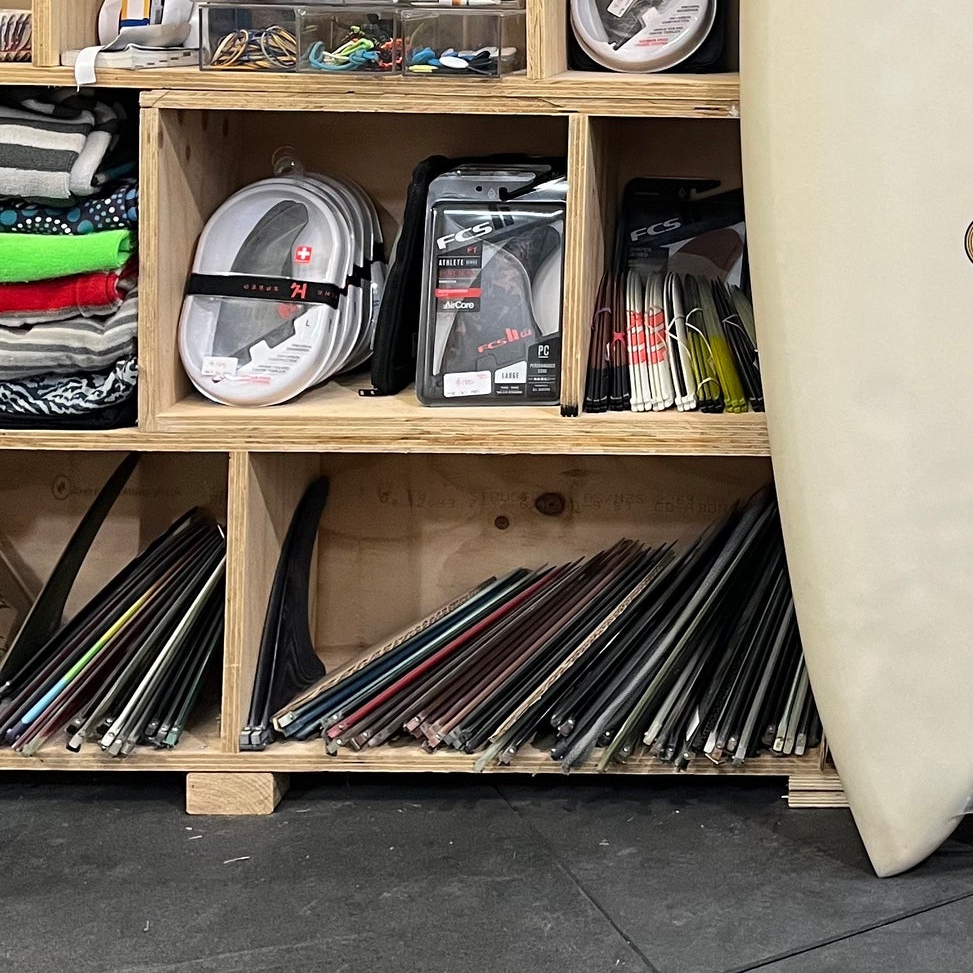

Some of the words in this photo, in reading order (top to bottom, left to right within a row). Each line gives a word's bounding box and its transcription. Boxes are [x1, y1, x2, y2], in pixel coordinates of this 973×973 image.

[630, 217, 682, 242] FCS
[435, 221, 493, 250] FCS
[438, 258, 464, 266] ATHLETE
[443, 300, 475, 310] AirCore
[538, 345, 550, 356] PC
